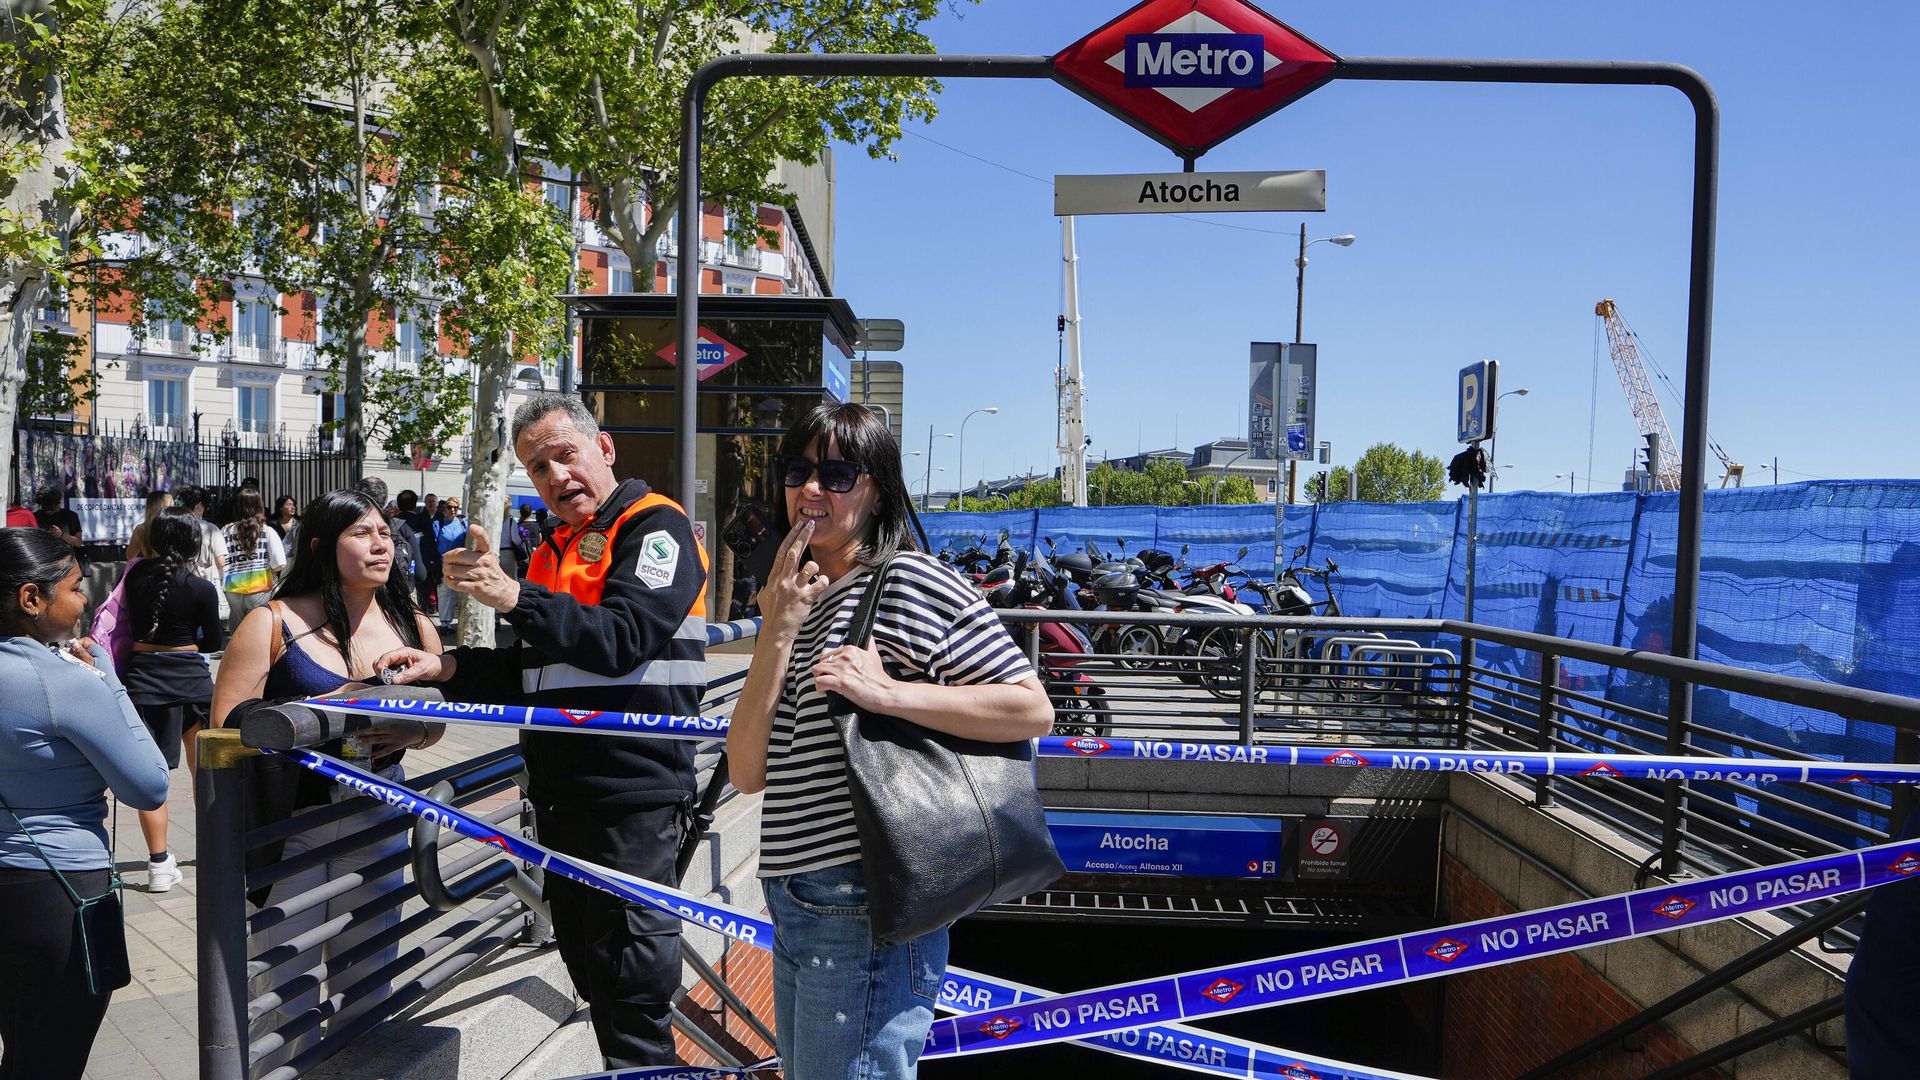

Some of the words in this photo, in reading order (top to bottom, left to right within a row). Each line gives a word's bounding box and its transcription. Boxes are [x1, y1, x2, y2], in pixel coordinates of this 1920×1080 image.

[1136, 41, 1254, 76] Metro
[1137, 179, 1240, 204] Atocha
[1461, 373, 1479, 433] P
[640, 564, 670, 581] SICOR
[622, 712, 662, 726] NO
[1077, 740, 1099, 750] Metro
[1133, 740, 1172, 759] NO
[1180, 743, 1268, 764] PASAR
[1335, 757, 1358, 766] Metro
[1391, 755, 1431, 770] NO
[1438, 758, 1526, 775] PASAR
[1099, 832, 1169, 850] Atocha
[1139, 862, 1170, 871] Alfonso
[1171, 863, 1183, 871] XII
[1709, 885, 1749, 909] NO
[1756, 868, 1841, 900] PASAR
[1663, 902, 1685, 912] Metro
[1480, 928, 1519, 953] NO
[1526, 911, 1610, 945] PASAR
[1436, 945, 1457, 955] Metro
[1256, 969, 1294, 994] NO
[1300, 953, 1384, 986] PASAR
[1212, 985, 1233, 995] Metro
[1033, 1007, 1071, 1032] NO
[1077, 993, 1160, 1024] PASAR
[989, 1021, 1010, 1031] Metro
[1146, 1032, 1227, 1067] PASAR
[1289, 1069, 1310, 1080] Metro
